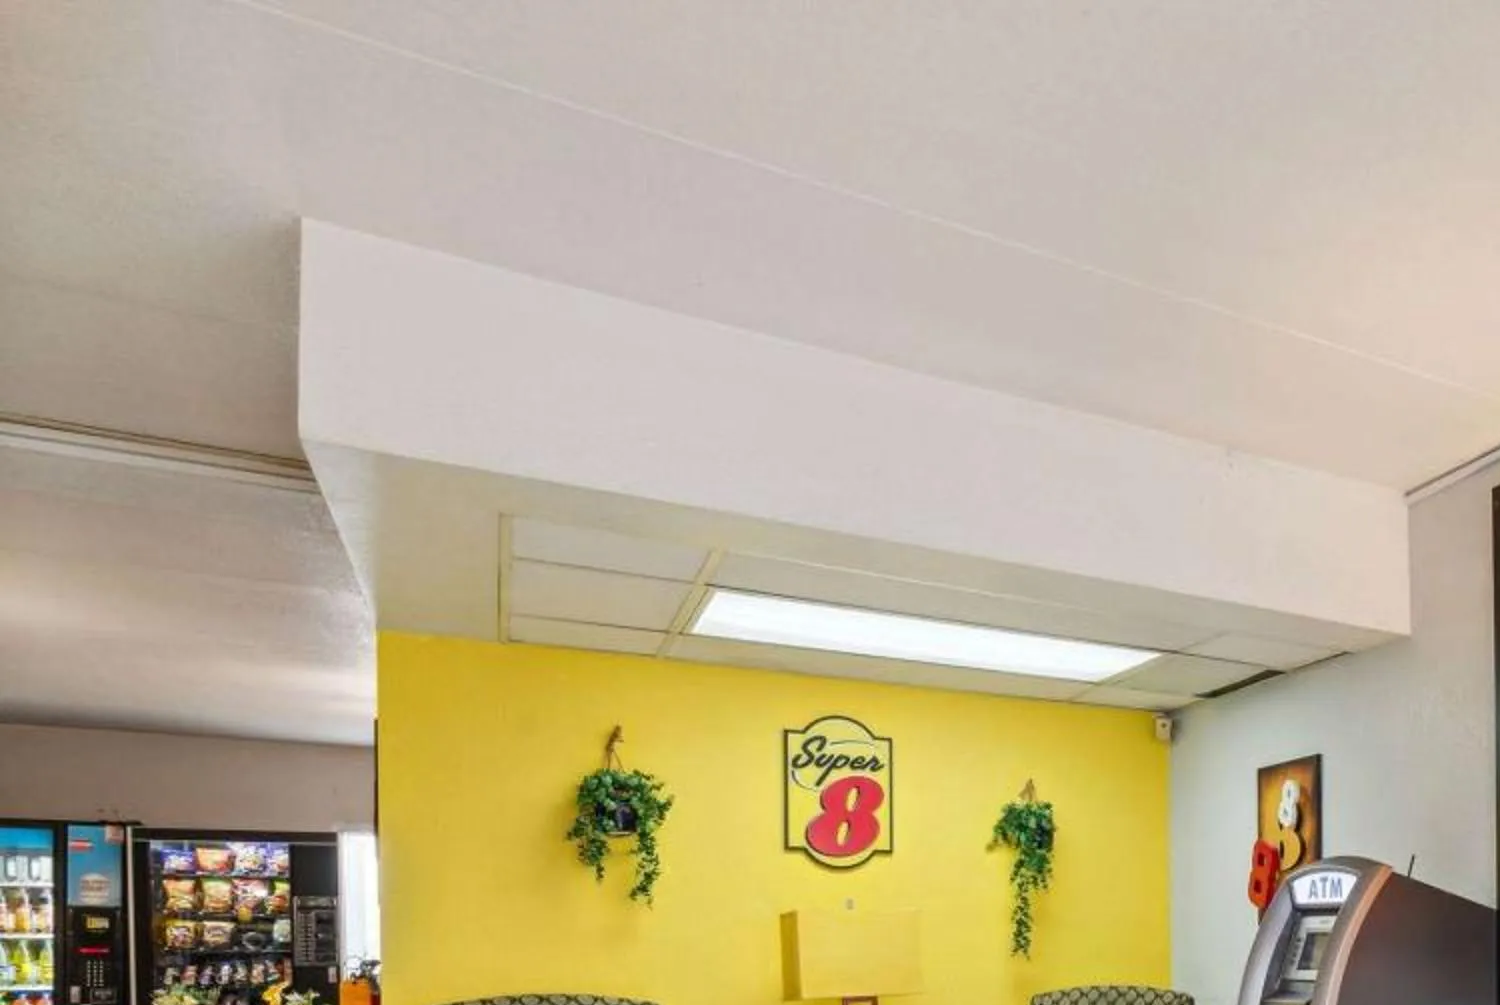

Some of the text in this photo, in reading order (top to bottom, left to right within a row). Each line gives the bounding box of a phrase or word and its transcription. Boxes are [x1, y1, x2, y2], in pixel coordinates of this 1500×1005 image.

[791, 734, 885, 787] Super
[804, 774, 886, 858] 8
[1307, 875, 1344, 900] ATM
